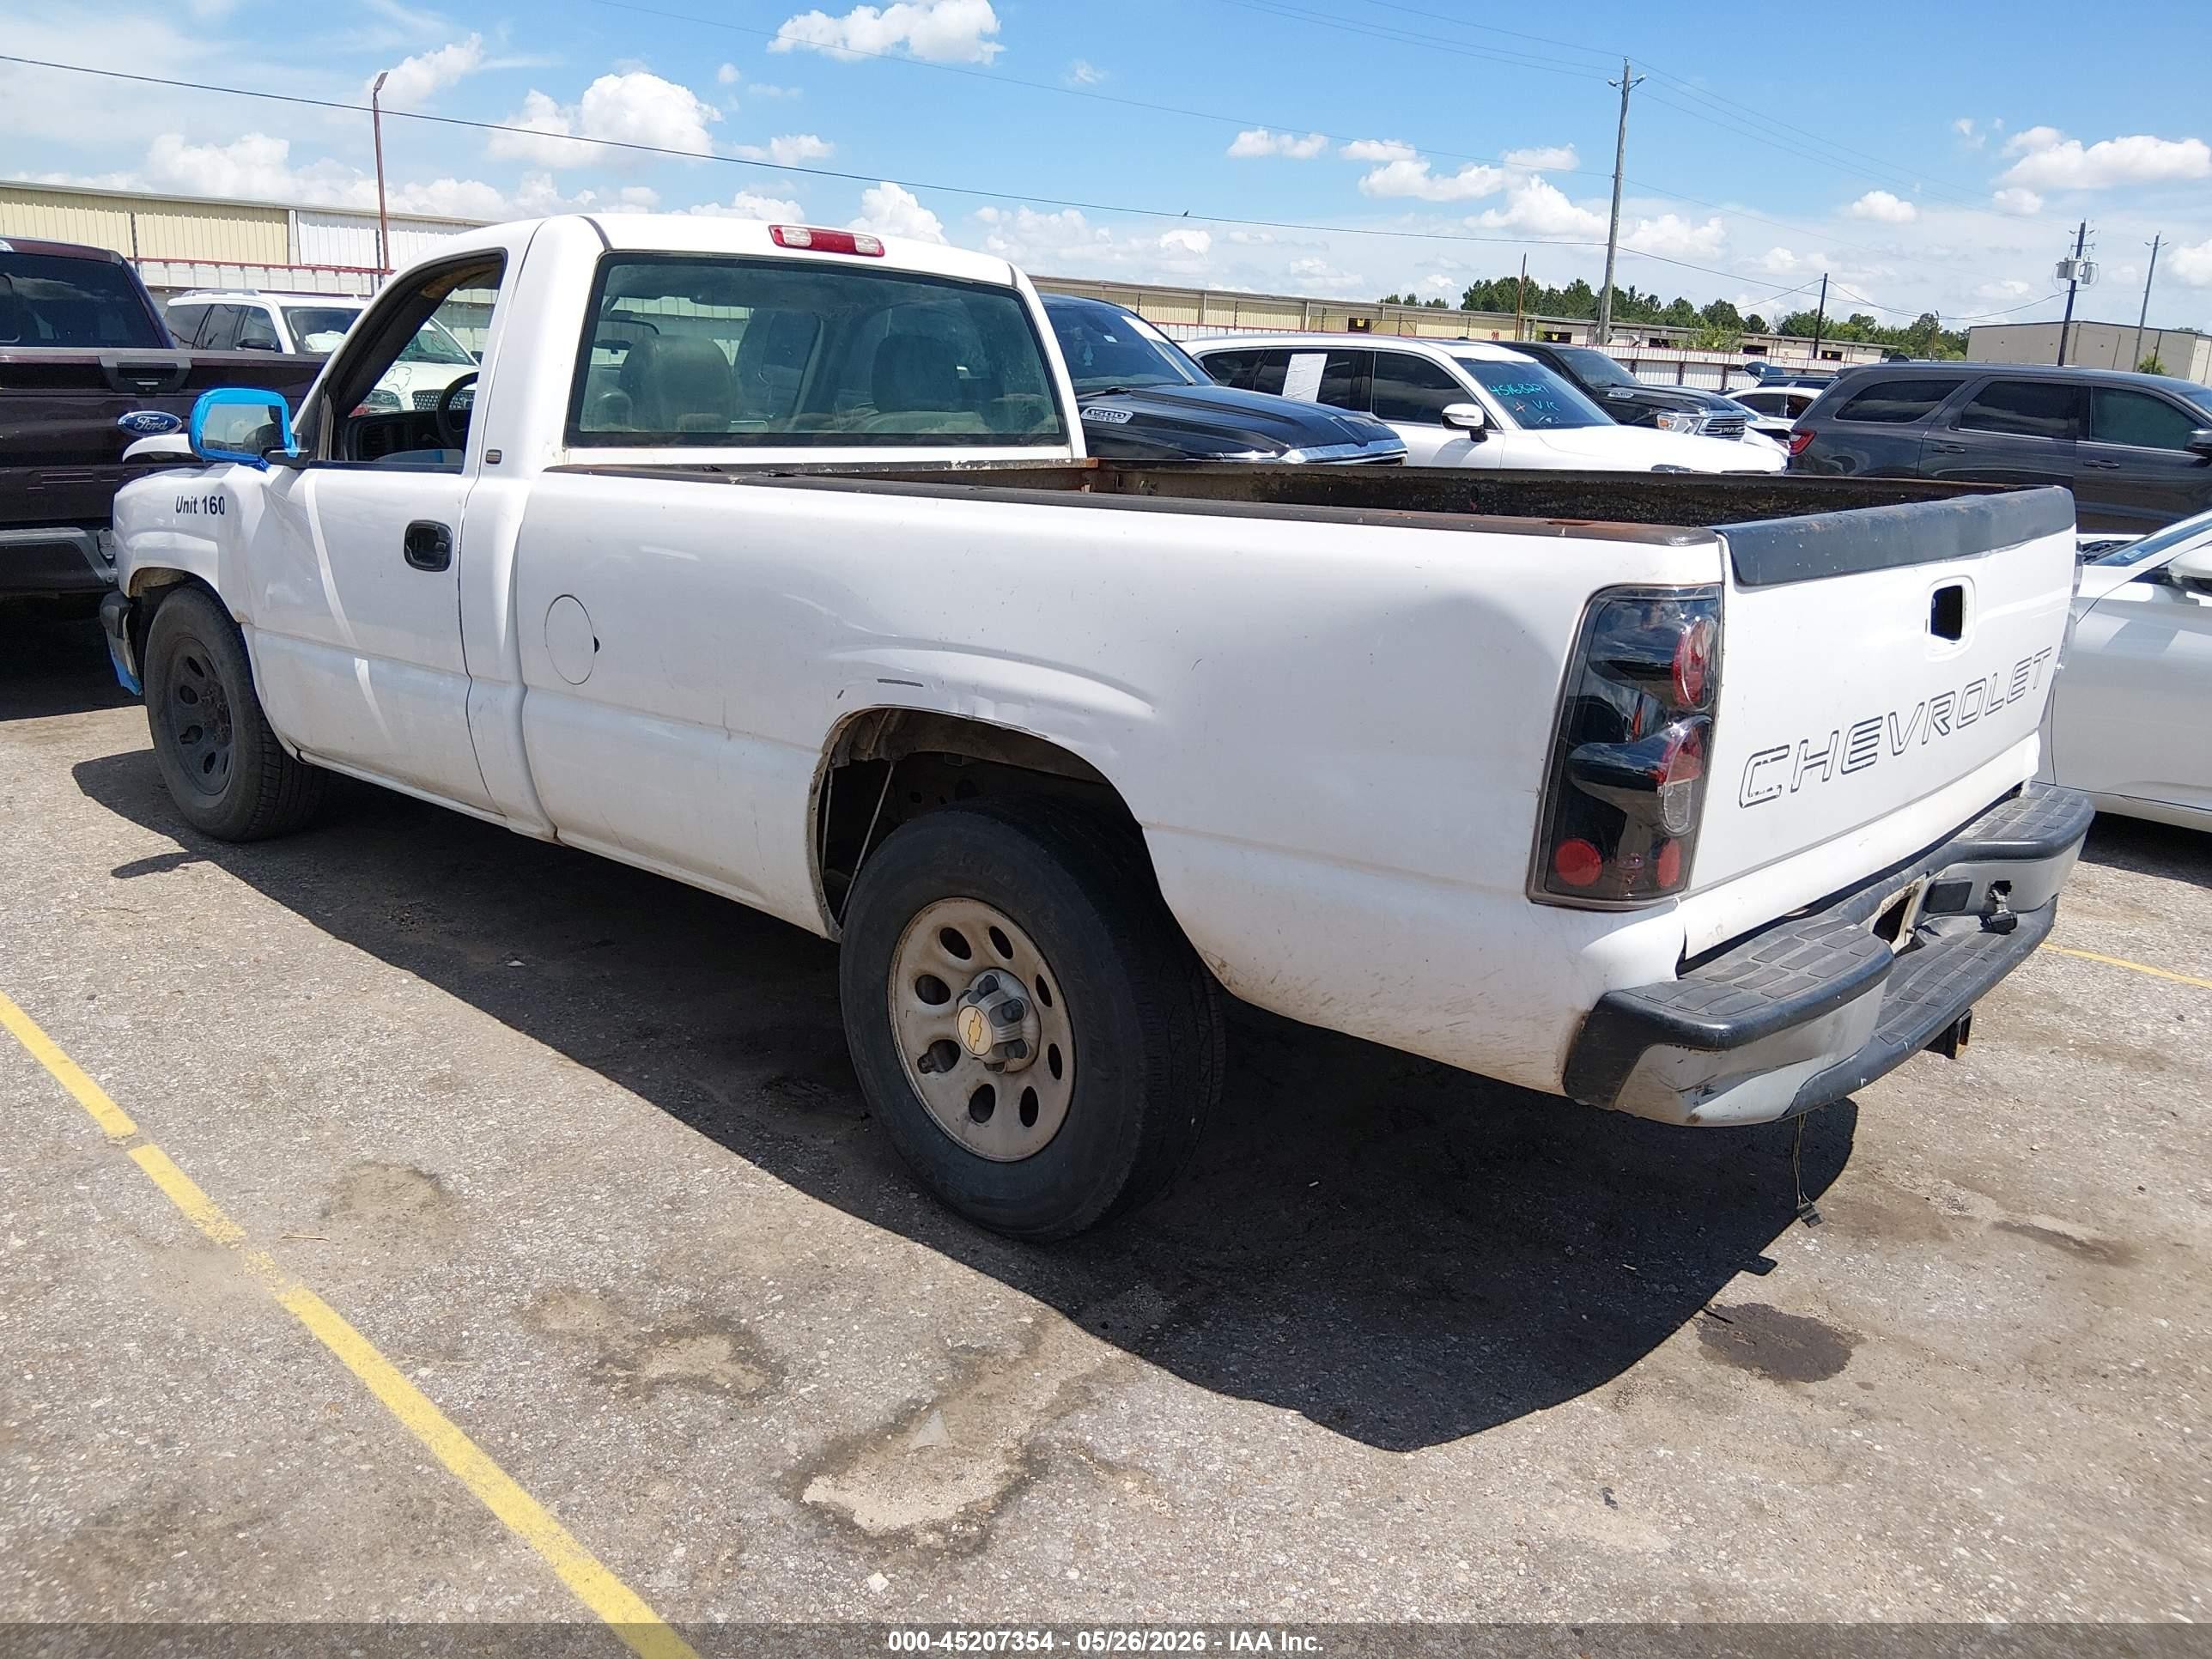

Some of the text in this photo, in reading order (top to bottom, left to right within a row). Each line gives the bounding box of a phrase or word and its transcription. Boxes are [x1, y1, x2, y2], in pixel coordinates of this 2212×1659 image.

[134, 416, 169, 431] Ford
[175, 495, 226, 515] Unit 160
[1739, 646, 2053, 809] CHEVROLET
